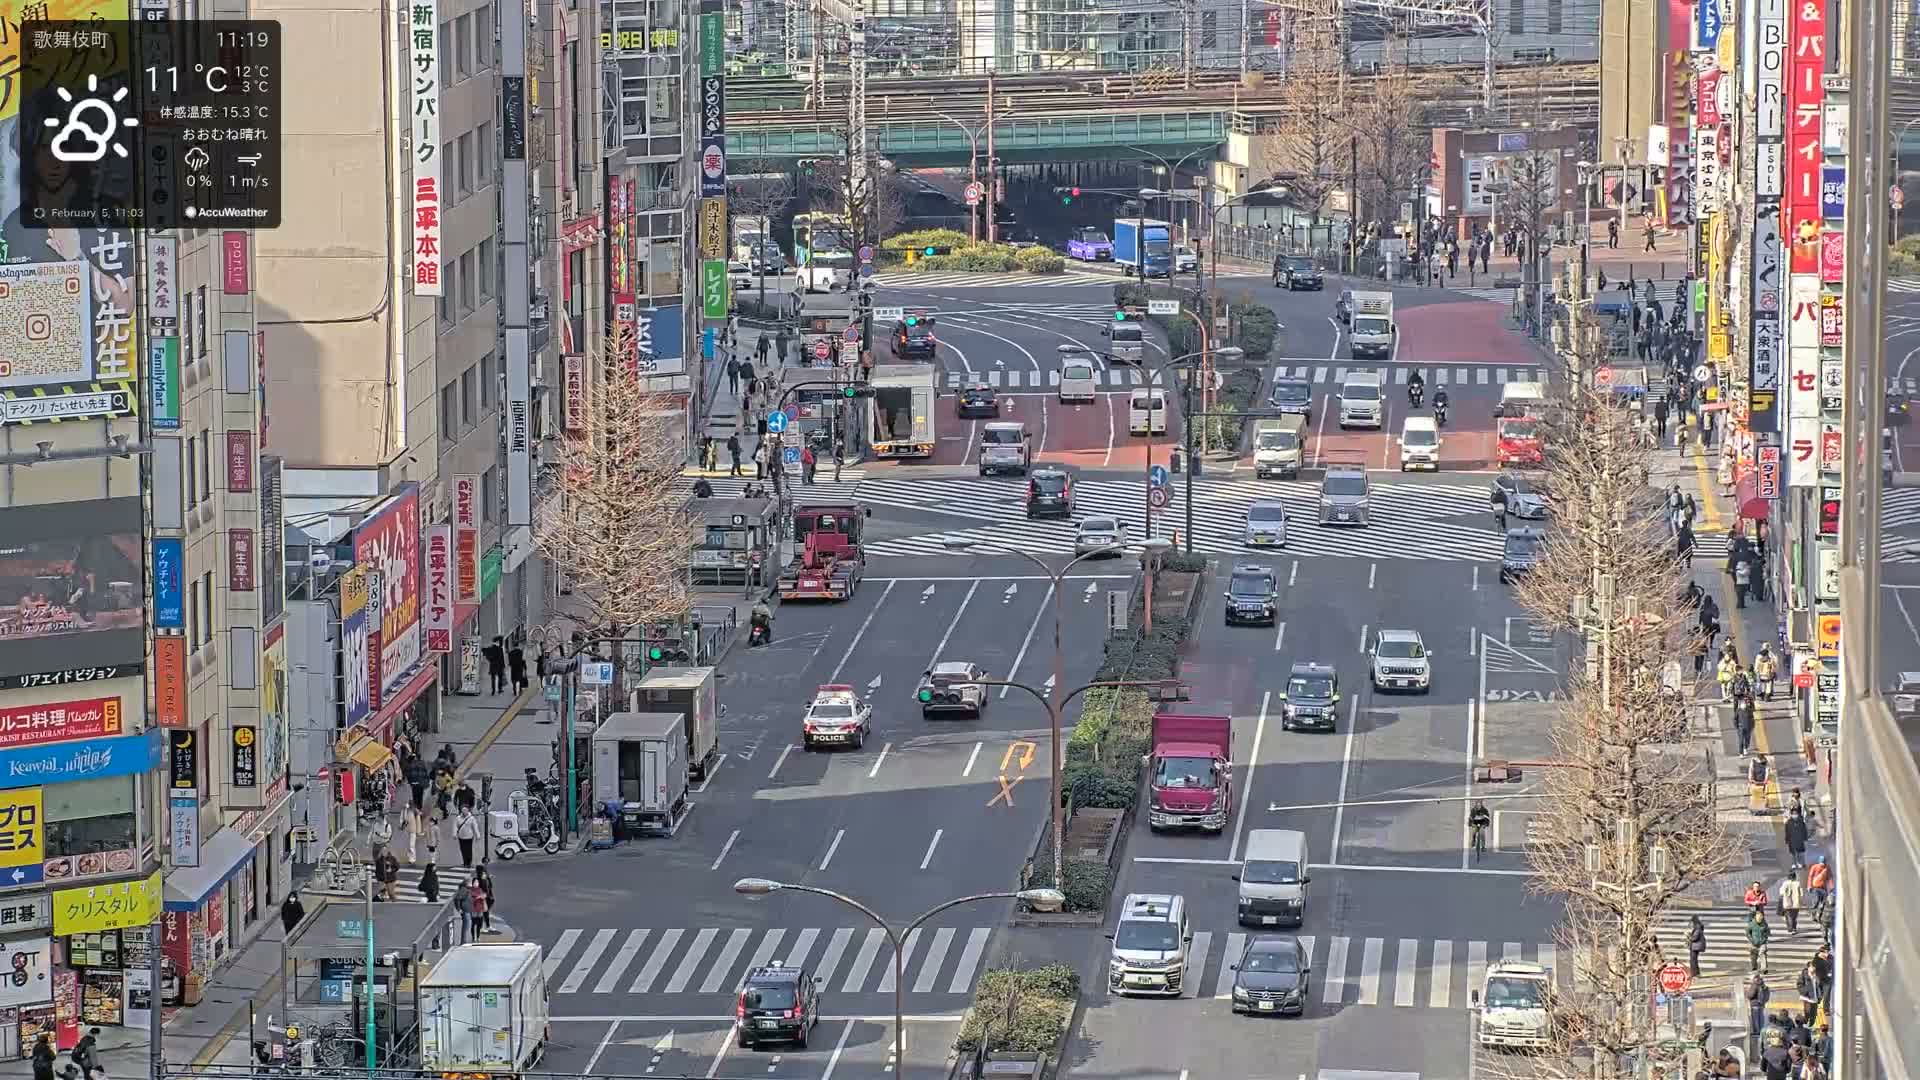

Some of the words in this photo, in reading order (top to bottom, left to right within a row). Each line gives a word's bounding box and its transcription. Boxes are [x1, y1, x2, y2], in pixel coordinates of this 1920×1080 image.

[147, 11, 165, 21] 6F
[618, 32, 643, 49] 祝日
[651, 30, 678, 48] 夜間
[413, 4, 436, 163] 新宿サンパーク
[1703, 80, 1715, 113] アコム
[705, 153, 721, 170] 薬
[415, 177, 439, 285] 三平本館
[707, 269, 721, 307] レイク
[1757, 323, 1771, 375] 大衆酒場
[152, 346, 166, 407] FamilyMart
[1792, 301, 1818, 461] パセラ
[9, 403, 45, 415] テンクリ
[50, 398, 109, 411] たいせい先生
[458, 480, 469, 524] GAME
[431, 536, 446, 622] 三平ストア
[67, 709, 102, 723] パムッカレ
[106, 704, 116, 729] 5F
[21, 728, 66, 741] RESTAURANT
[813, 733, 845, 742] POLICE
[1, 904, 36, 924] 囲碁
[67, 896, 139, 920] クリスタル
[324, 984, 339, 997] 12
